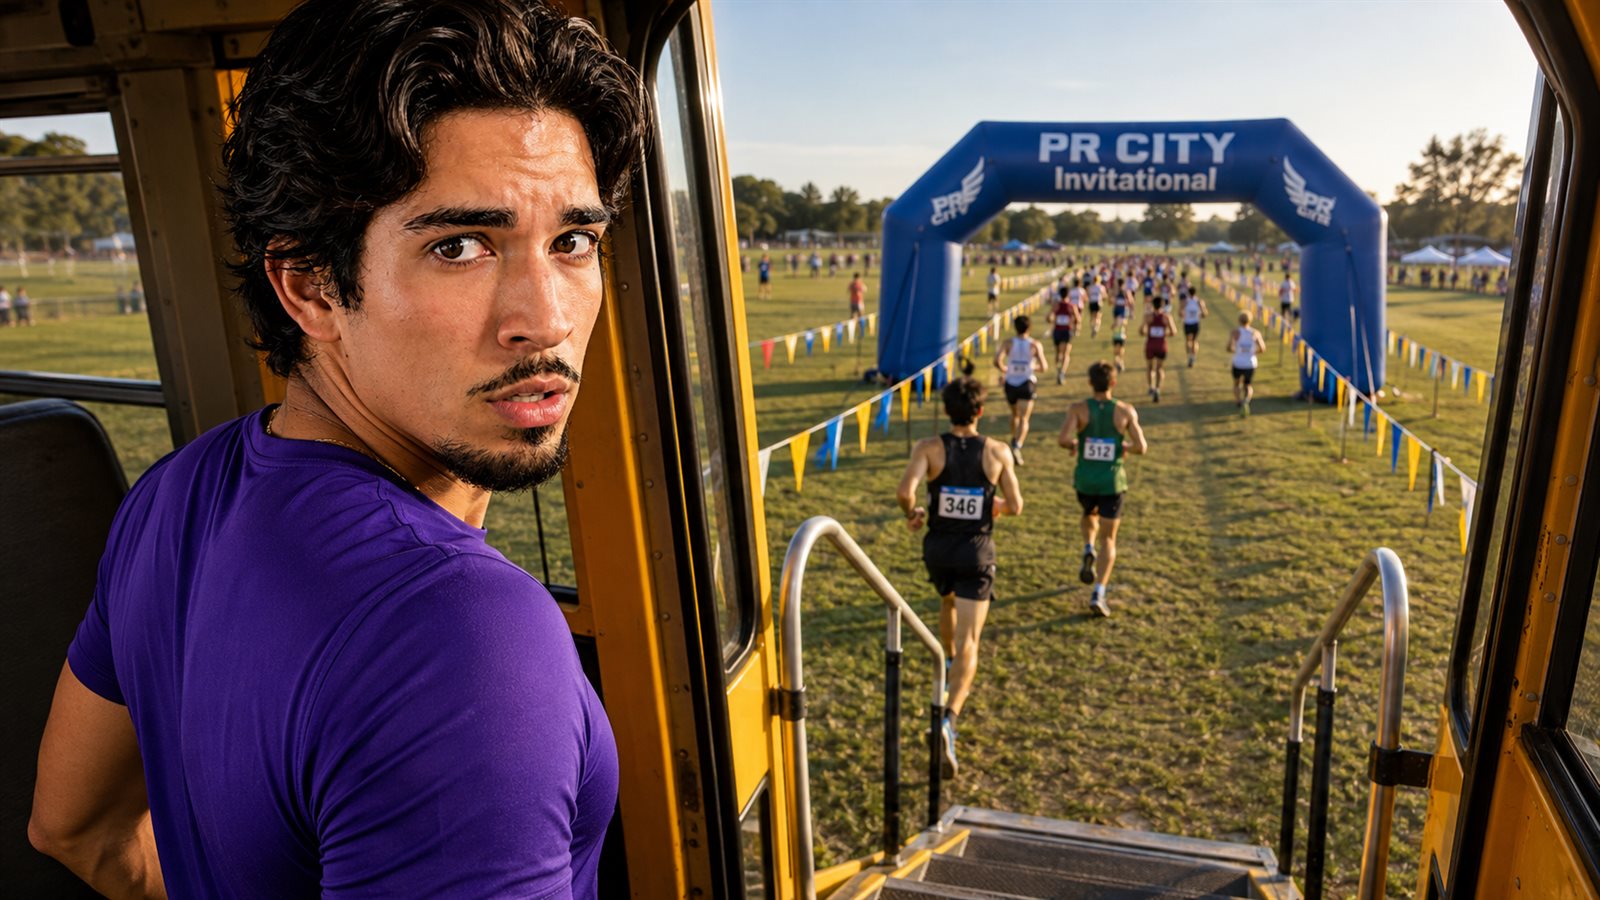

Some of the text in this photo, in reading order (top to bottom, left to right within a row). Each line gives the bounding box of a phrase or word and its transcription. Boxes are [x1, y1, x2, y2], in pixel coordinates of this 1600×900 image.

[1038, 132, 1235, 164] PR CITY
[1055, 166, 1217, 191] Invitational
[931, 191, 963, 214] PR
[1304, 190, 1336, 215] PR
[1088, 445, 1110, 458] 512
[945, 496, 976, 515] 346
